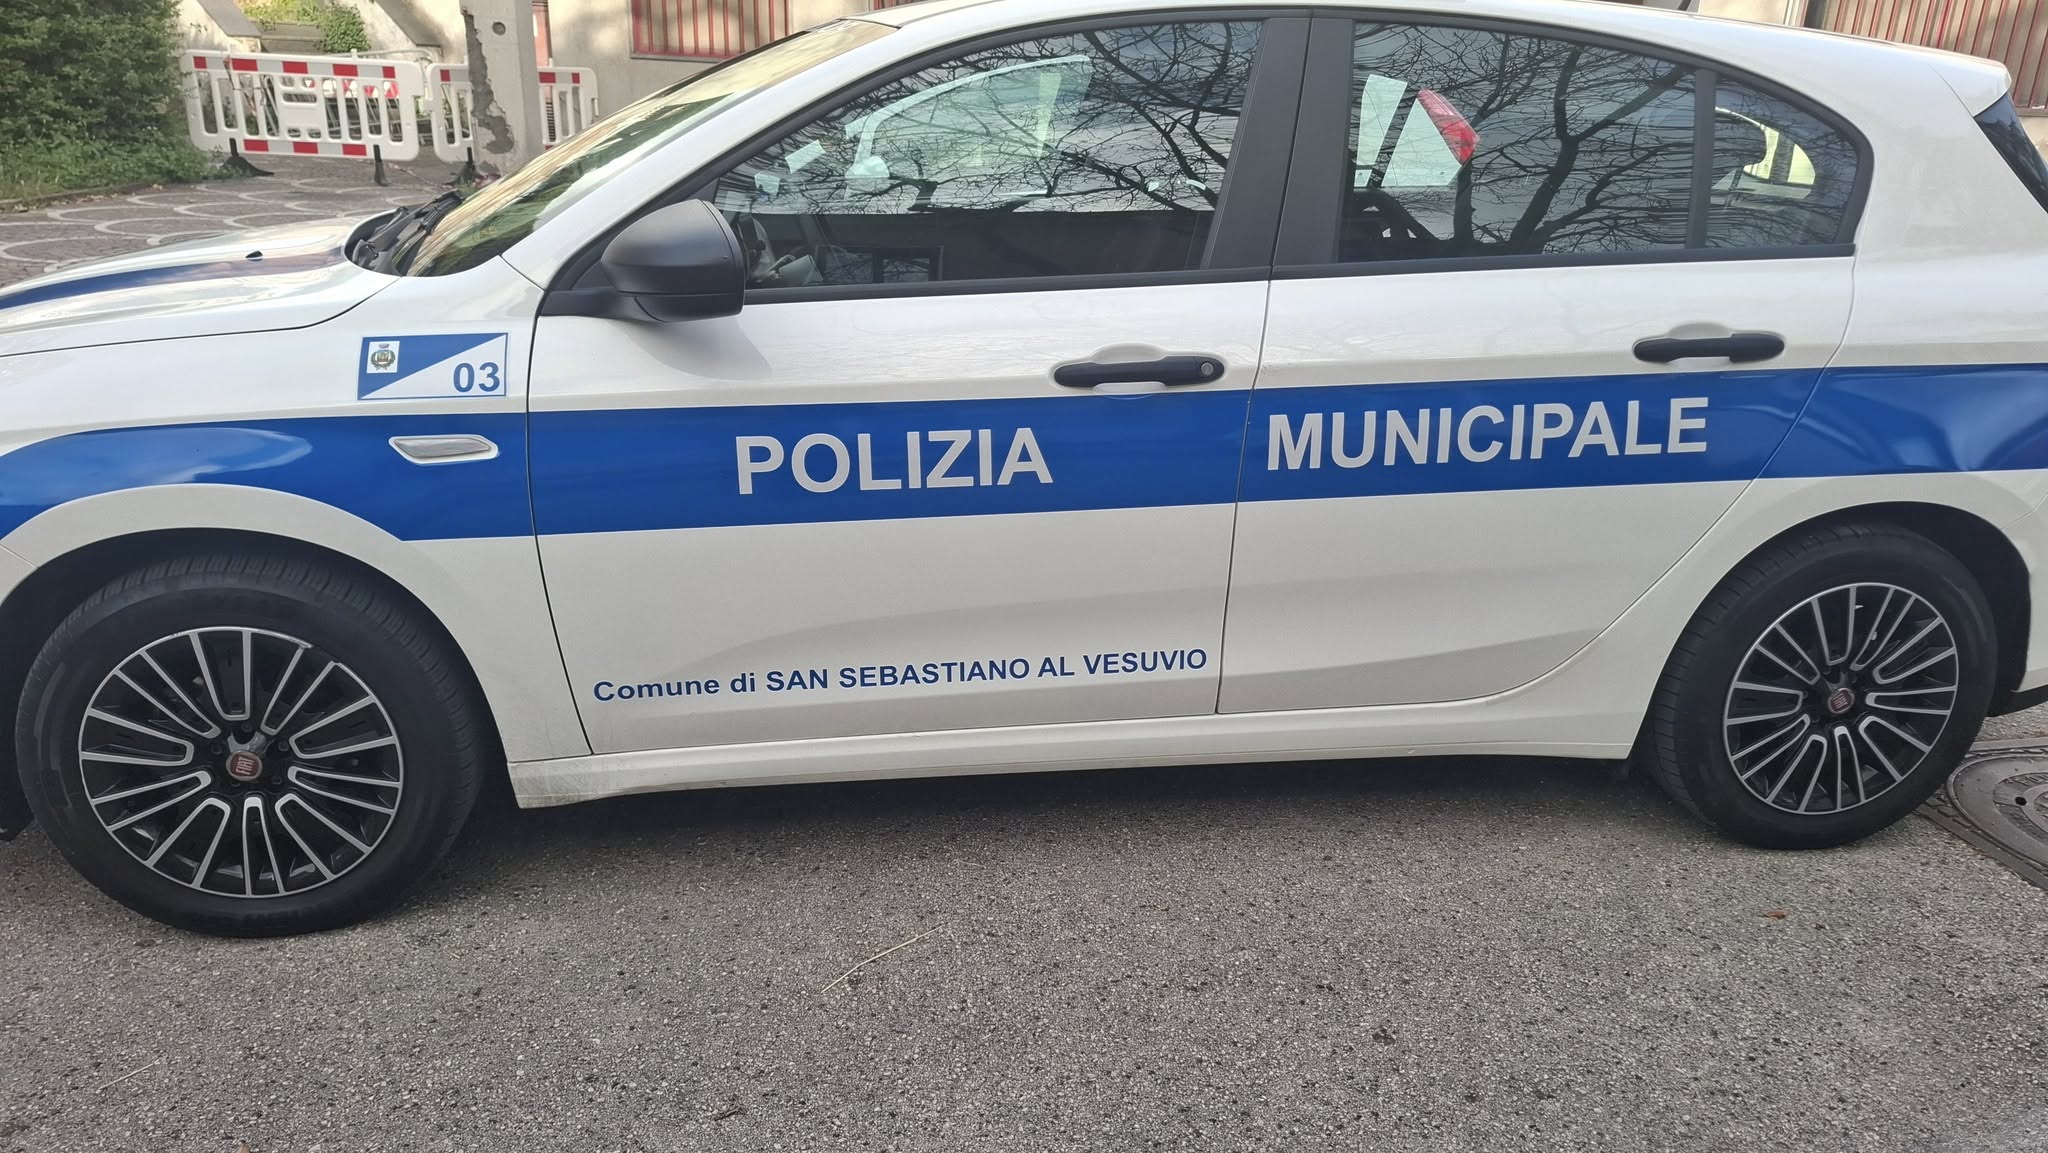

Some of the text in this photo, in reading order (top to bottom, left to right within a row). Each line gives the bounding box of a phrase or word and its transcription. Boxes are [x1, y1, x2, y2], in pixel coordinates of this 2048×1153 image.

[453, 362, 501, 393] 03
[735, 396, 1709, 495] POLIZIA MUNICIPALE
[593, 648, 1207, 702] Comune di SAN SEBASTIANO AL VESUVIO
[235, 755, 255, 775] FIAT
